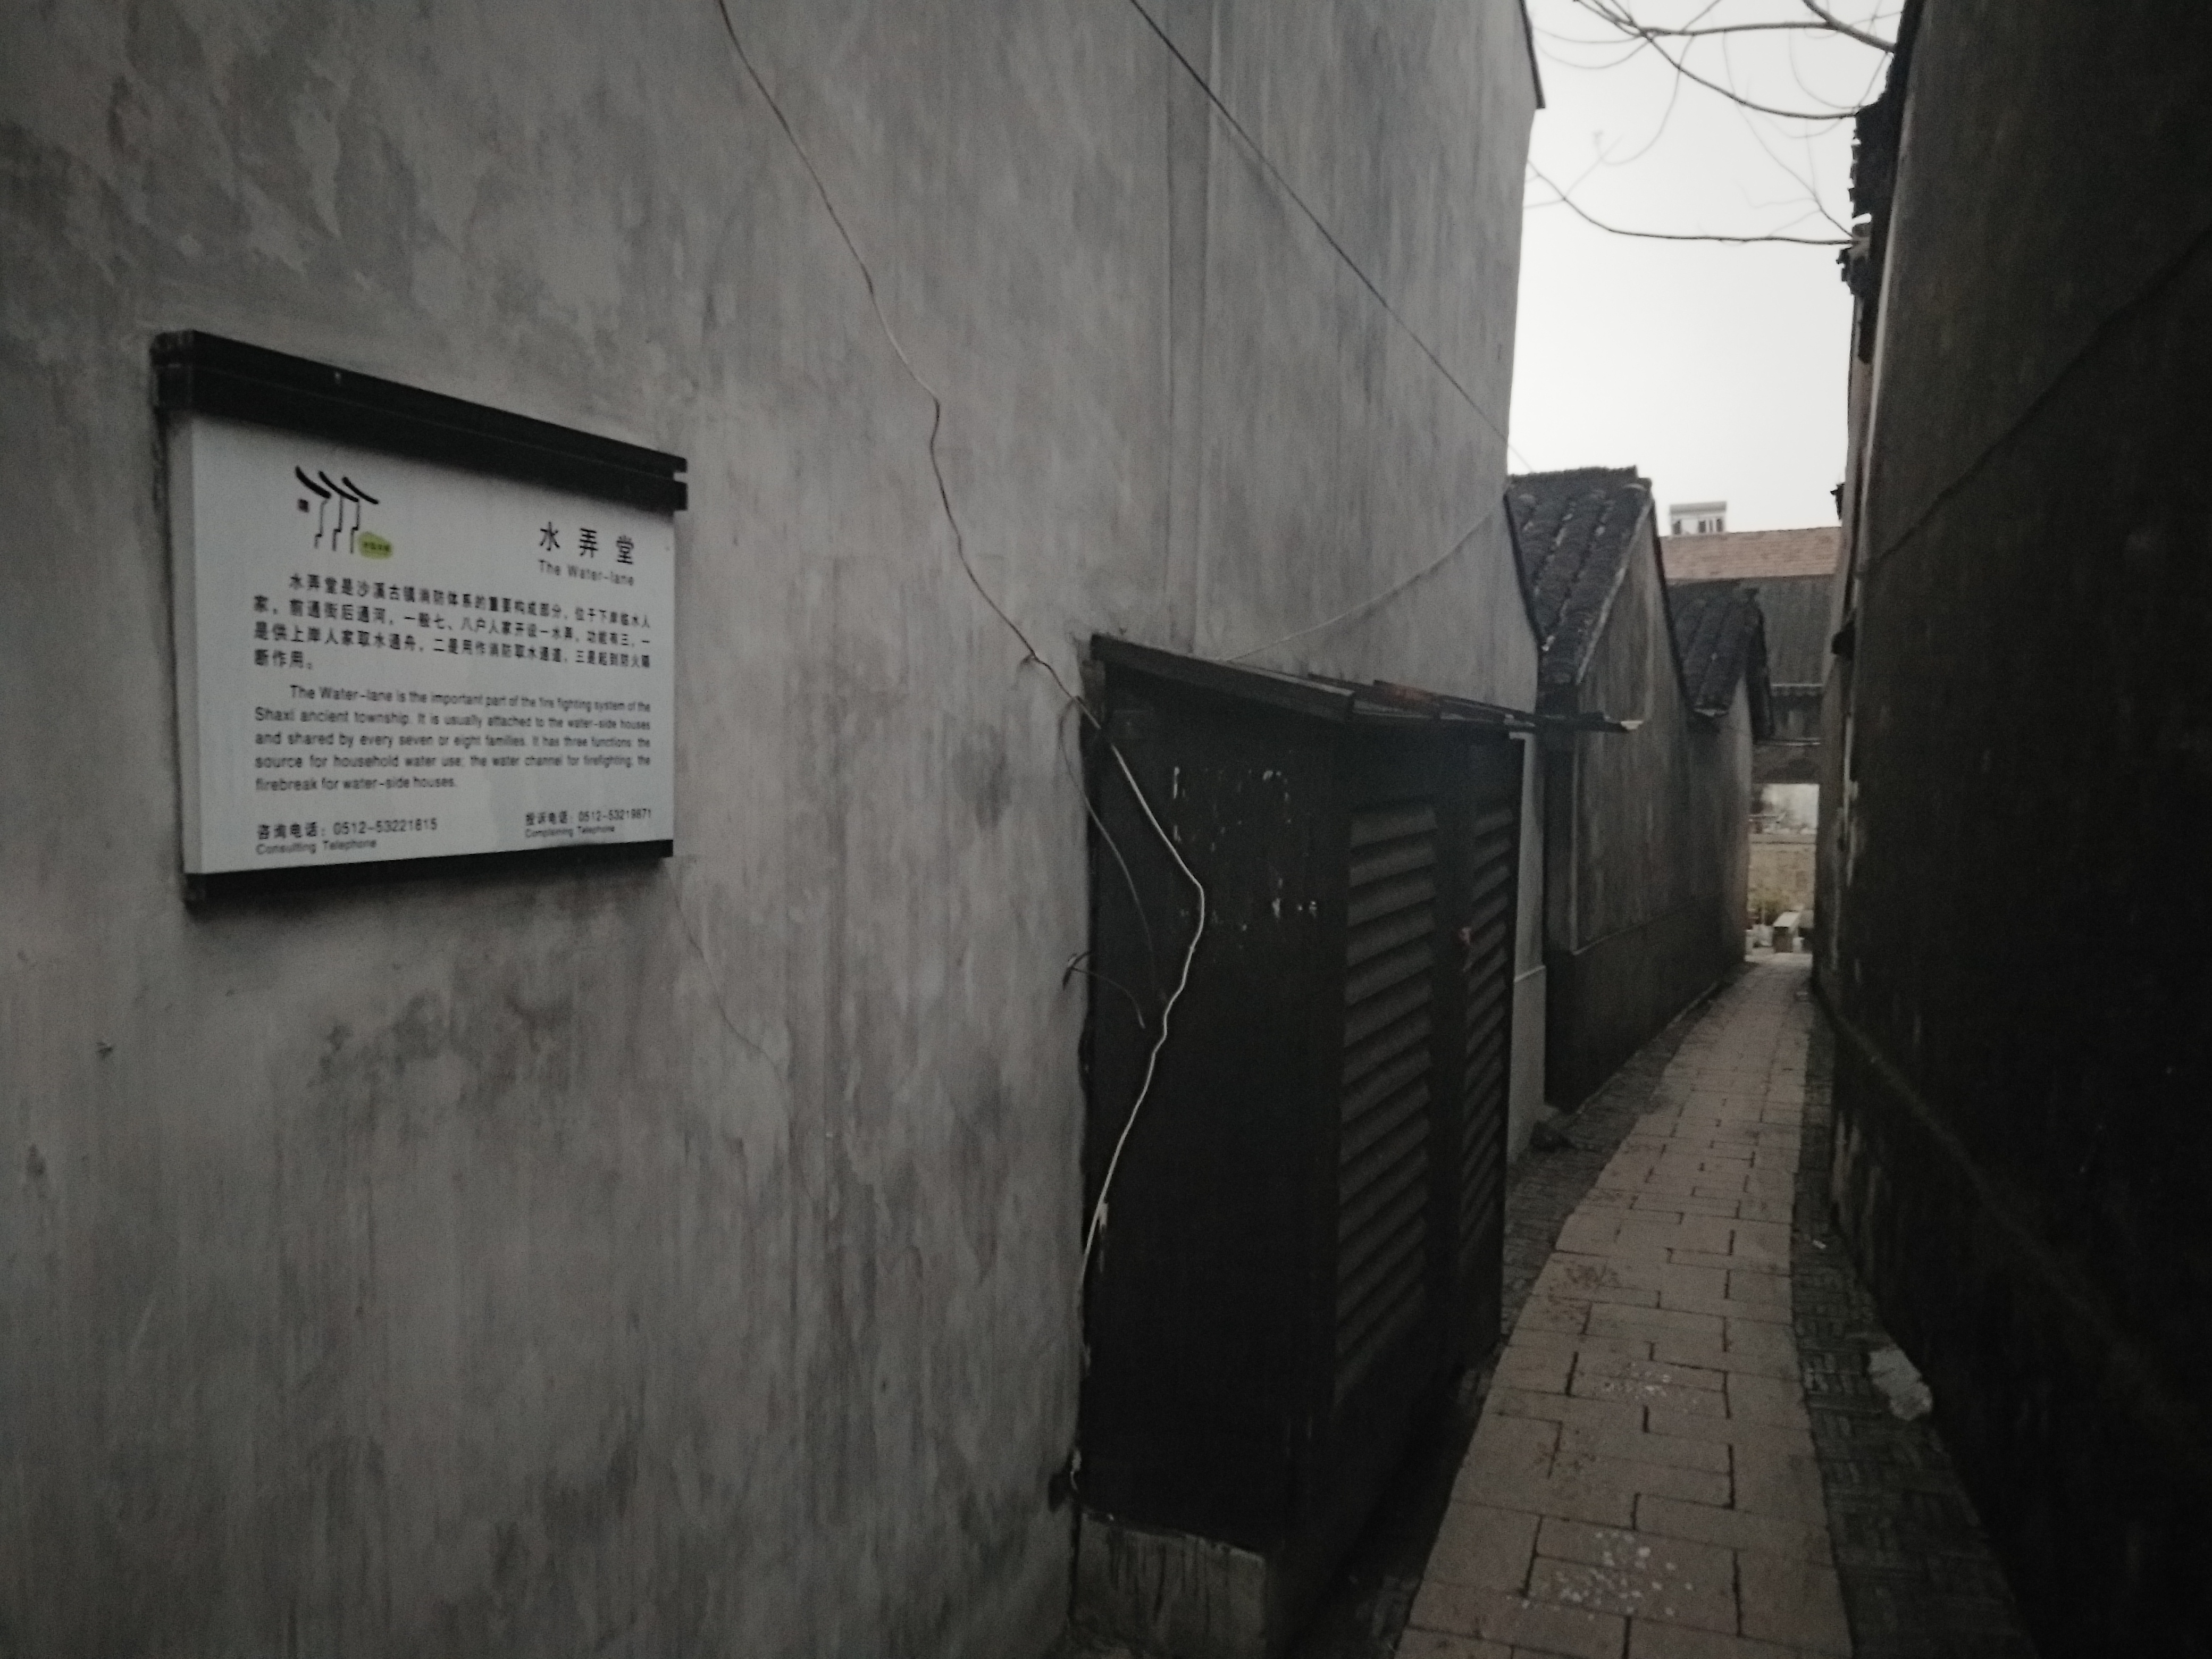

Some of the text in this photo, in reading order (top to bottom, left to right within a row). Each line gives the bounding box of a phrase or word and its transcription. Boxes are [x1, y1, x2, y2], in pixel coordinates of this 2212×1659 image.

[540, 521, 634, 564] 水弄堂
[539, 559, 634, 585] The Water-lane
[290, 685, 315, 699] The
[320, 686, 392, 701] Water-lane
[397, 690, 406, 702] is
[409, 690, 428, 703] the
[430, 691, 483, 706] important
[485, 696, 506, 708] part
[509, 695, 518, 707] of
[521, 696, 536, 708] the
[638, 701, 650, 713] the
[255, 706, 295, 721] Shaxi
[300, 710, 349, 722] ancient
[417, 713, 425, 725] It
[430, 714, 439, 725] is
[444, 715, 482, 728] usually
[488, 715, 531, 727] attached
[535, 717, 544, 727] to
[548, 717, 563, 728] the
[620, 719, 650, 730] houses
[255, 732, 281, 745] and
[287, 732, 334, 745] shared
[339, 733, 354, 748] by
[359, 735, 393, 749] every
[399, 735, 433, 745] seven
[439, 736, 449, 745] or
[454, 735, 481, 749] eight
[542, 736, 559, 747] has
[564, 735, 588, 747] three
[638, 737, 650, 747] the
[255, 756, 303, 768] source
[309, 755, 328, 768] for
[333, 755, 399, 768] household
[405, 756, 435, 767] water
[470, 756, 487, 766] the
[492, 757, 519, 766] water
[525, 756, 563, 766] channel
[567, 756, 580, 766] for
[638, 755, 650, 766] the
[255, 777, 317, 791] firebreak
[321, 778, 338, 790] for
[323, 839, 376, 851] Telephone
